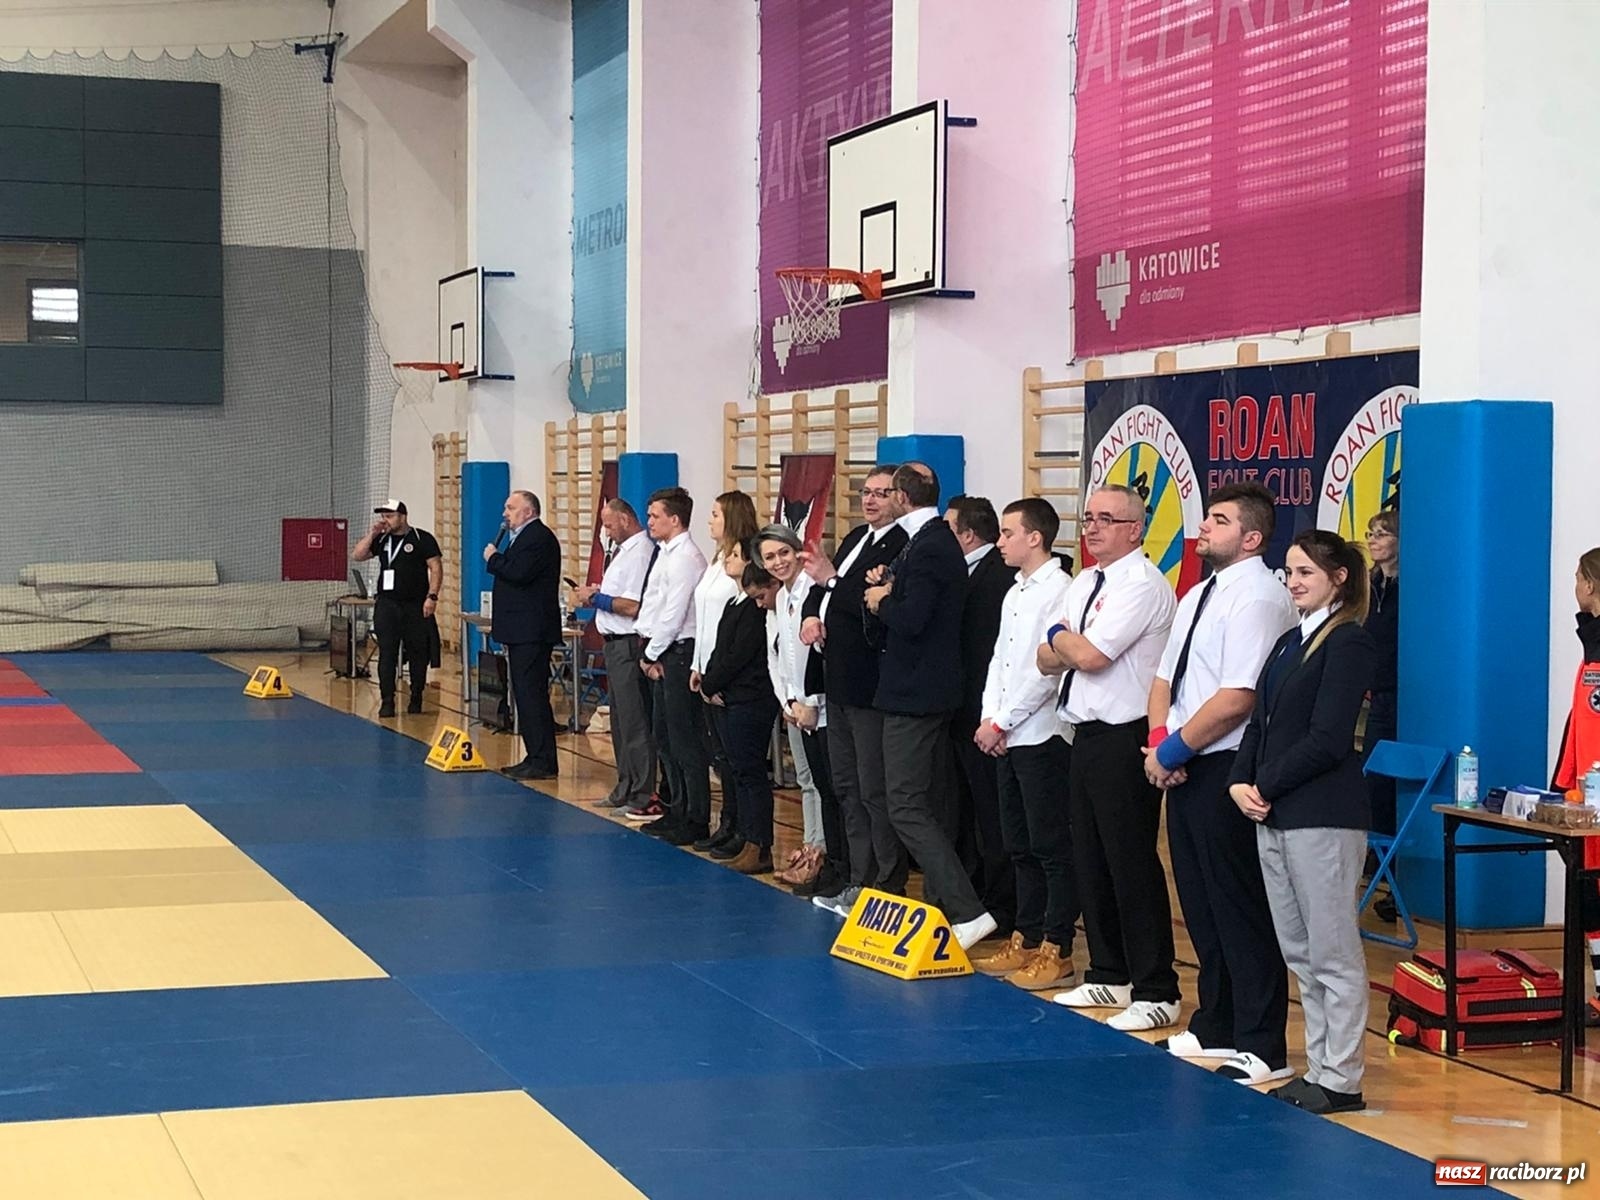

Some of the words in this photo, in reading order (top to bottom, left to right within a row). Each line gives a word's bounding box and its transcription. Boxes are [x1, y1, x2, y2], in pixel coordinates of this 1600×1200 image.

[1139, 242, 1220, 282] KATOWICE
[1208, 392, 1316, 462] ROAN
[1091, 426, 1125, 495] OAN
[1126, 411, 1163, 442] FIGHT
[1164, 432, 1193, 500] CLUB
[1325, 411, 1377, 505] ROAN
[1263, 467, 1313, 506] CLUB
[273, 675, 282, 691] 4
[461, 741, 473, 762] 3
[857, 897, 909, 937] MATA
[893, 907, 927, 958] 2
[933, 926, 950, 961] 2
